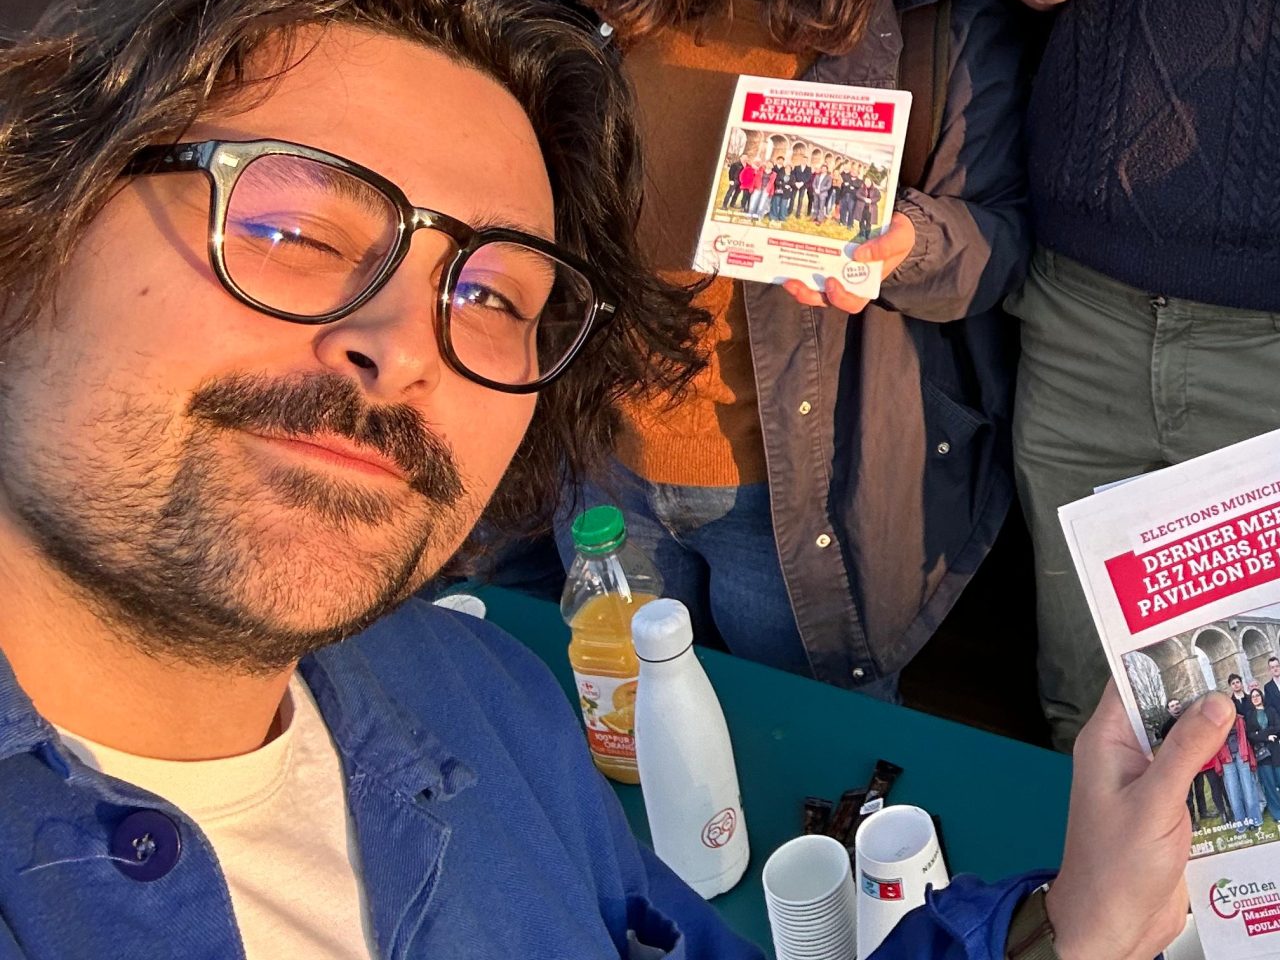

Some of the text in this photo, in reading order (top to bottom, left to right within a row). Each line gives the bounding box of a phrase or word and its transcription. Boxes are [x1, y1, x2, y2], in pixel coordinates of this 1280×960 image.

[760, 104, 775, 112] LE
[862, 113, 879, 121] AU
[764, 98, 874, 112] DERNIER MEETING
[752, 111, 812, 124] PAVILLON
[813, 117, 828, 125] DE
[1140, 505, 1219, 543] ELECTIONS
[1142, 525, 1237, 573] DERNIER
[1143, 571, 1172, 593] LE
[1171, 564, 1184, 581] 7
[1187, 540, 1257, 576] MARS,
[1137, 563, 1244, 617] PAVILLON
[1245, 552, 1275, 574] DE
[1213, 820, 1242, 833] soutien
[1243, 817, 1254, 825] de
[1262, 881, 1276, 891] en
